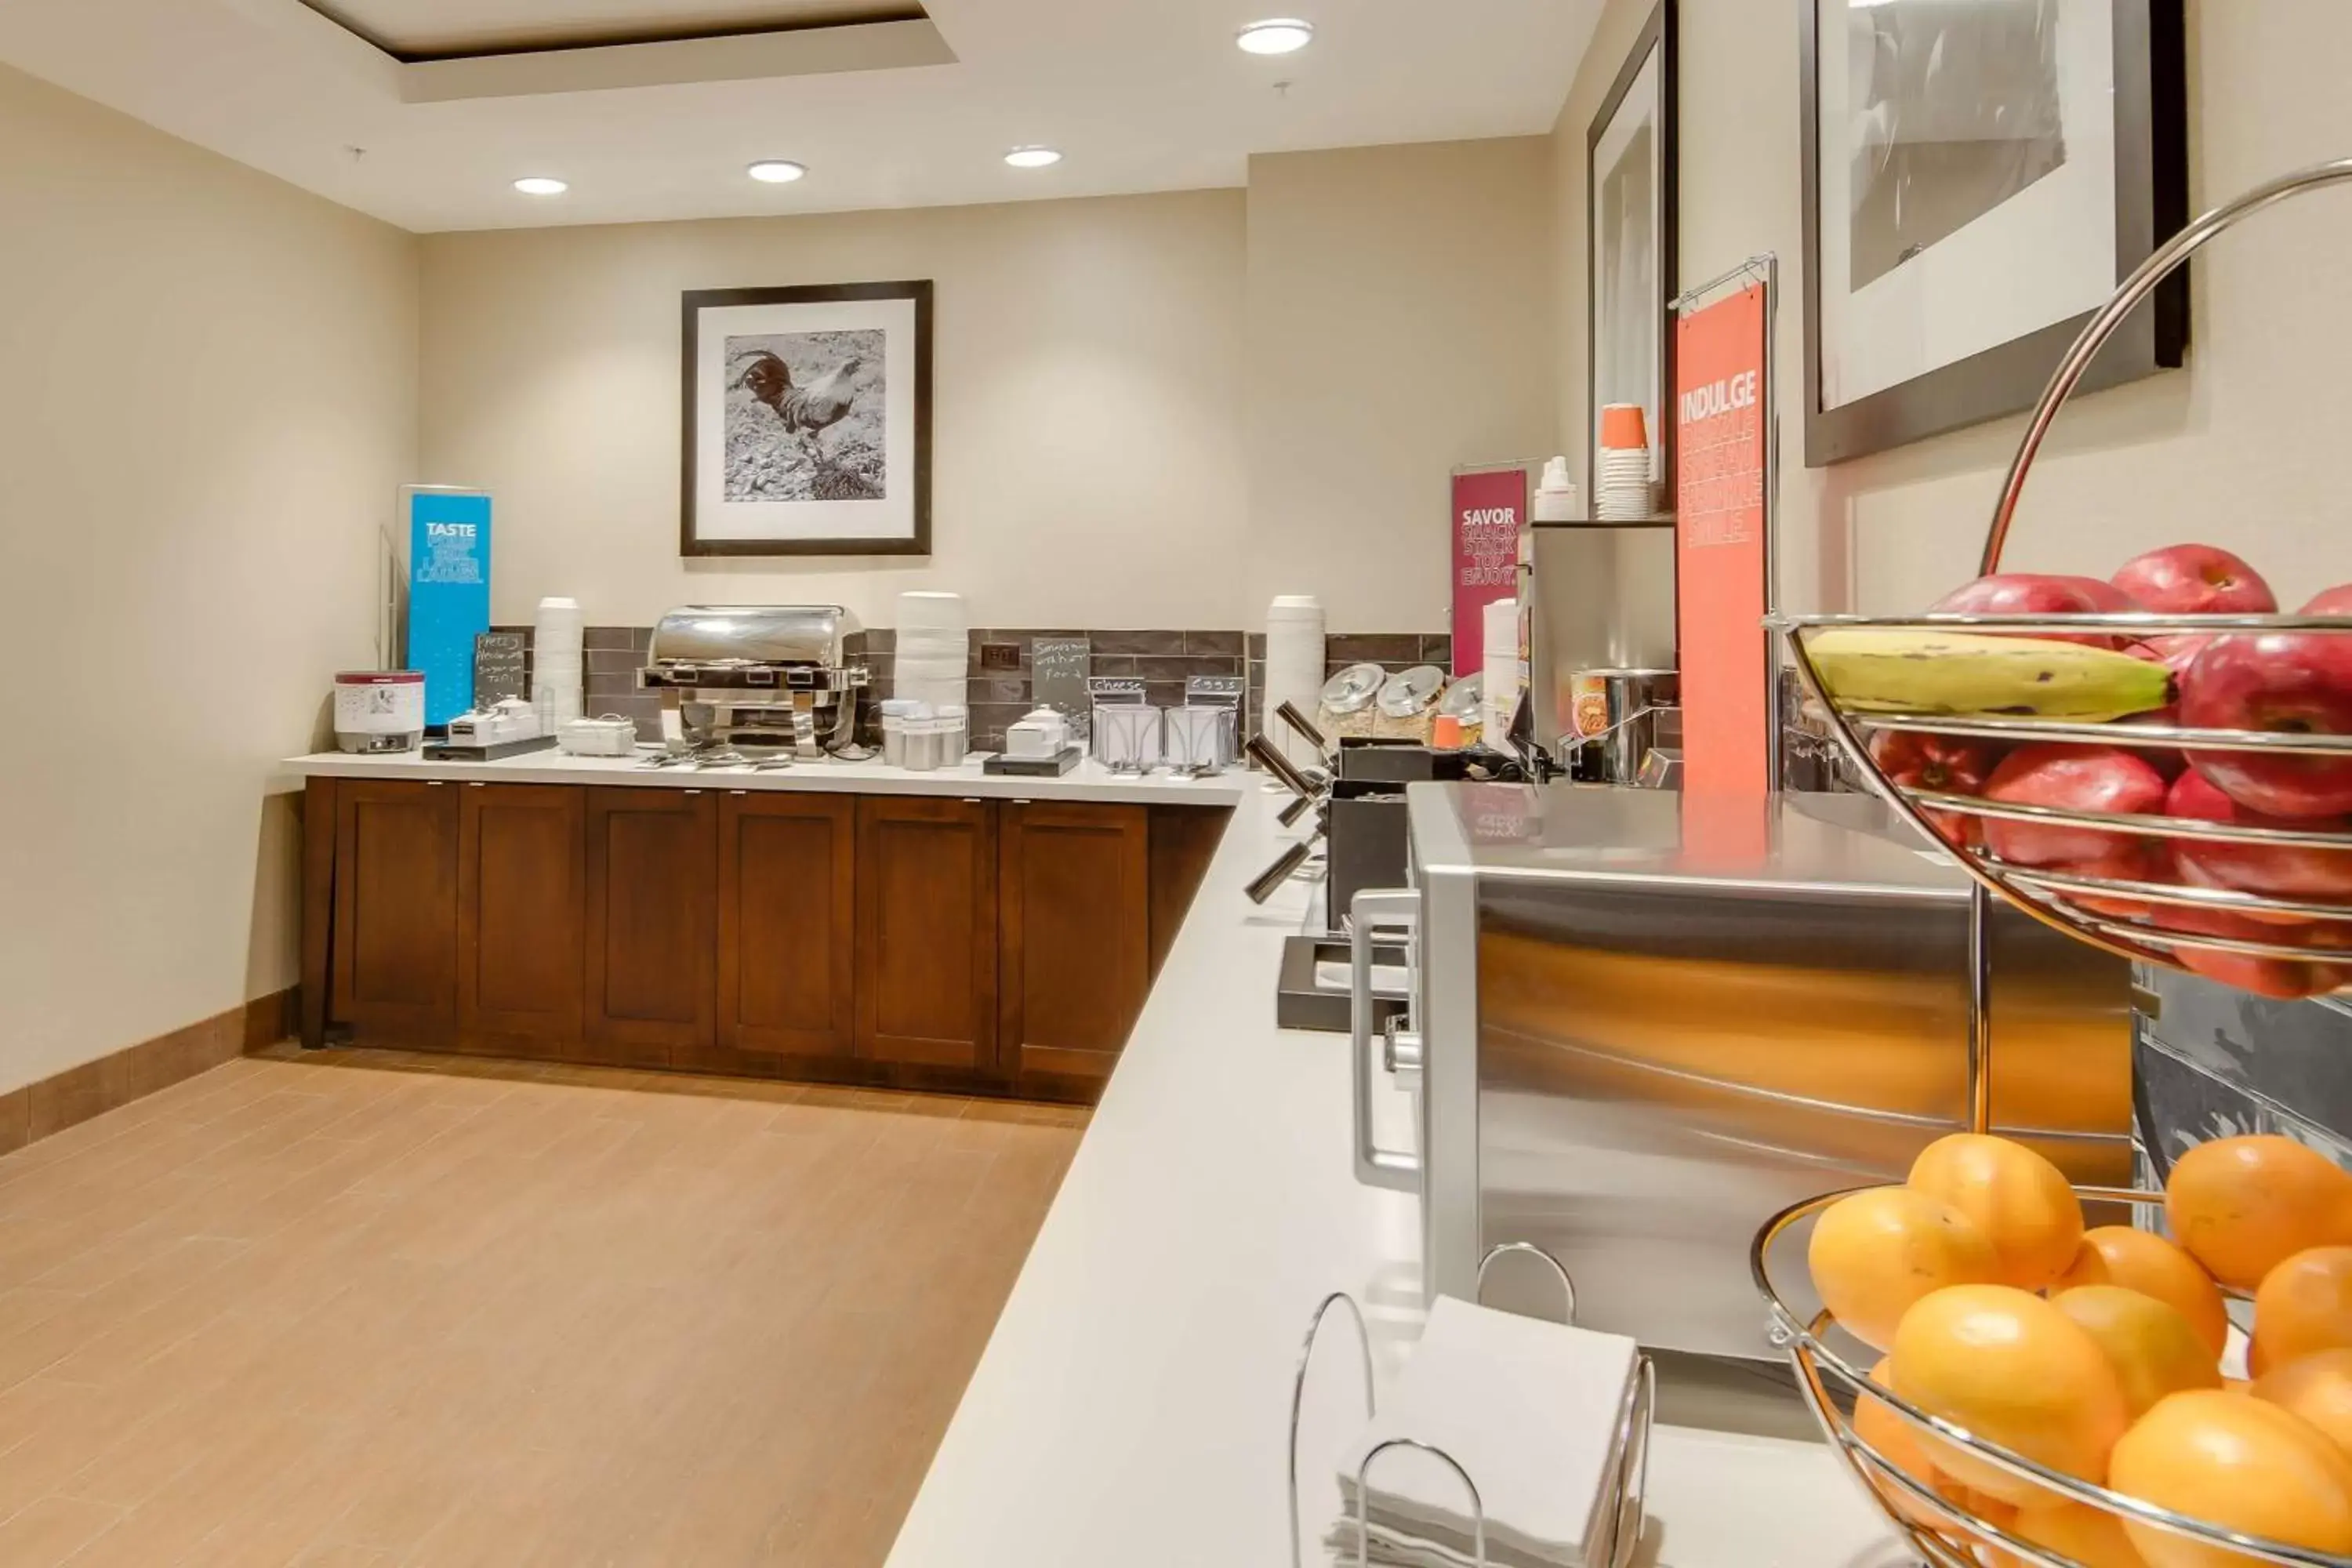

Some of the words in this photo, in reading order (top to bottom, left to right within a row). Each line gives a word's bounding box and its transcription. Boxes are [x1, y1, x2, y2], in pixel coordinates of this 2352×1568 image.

[1680, 369, 1756, 425] INDULGE
[1462, 507, 1515, 525] SAVOR
[426, 523, 477, 537] TASTE
